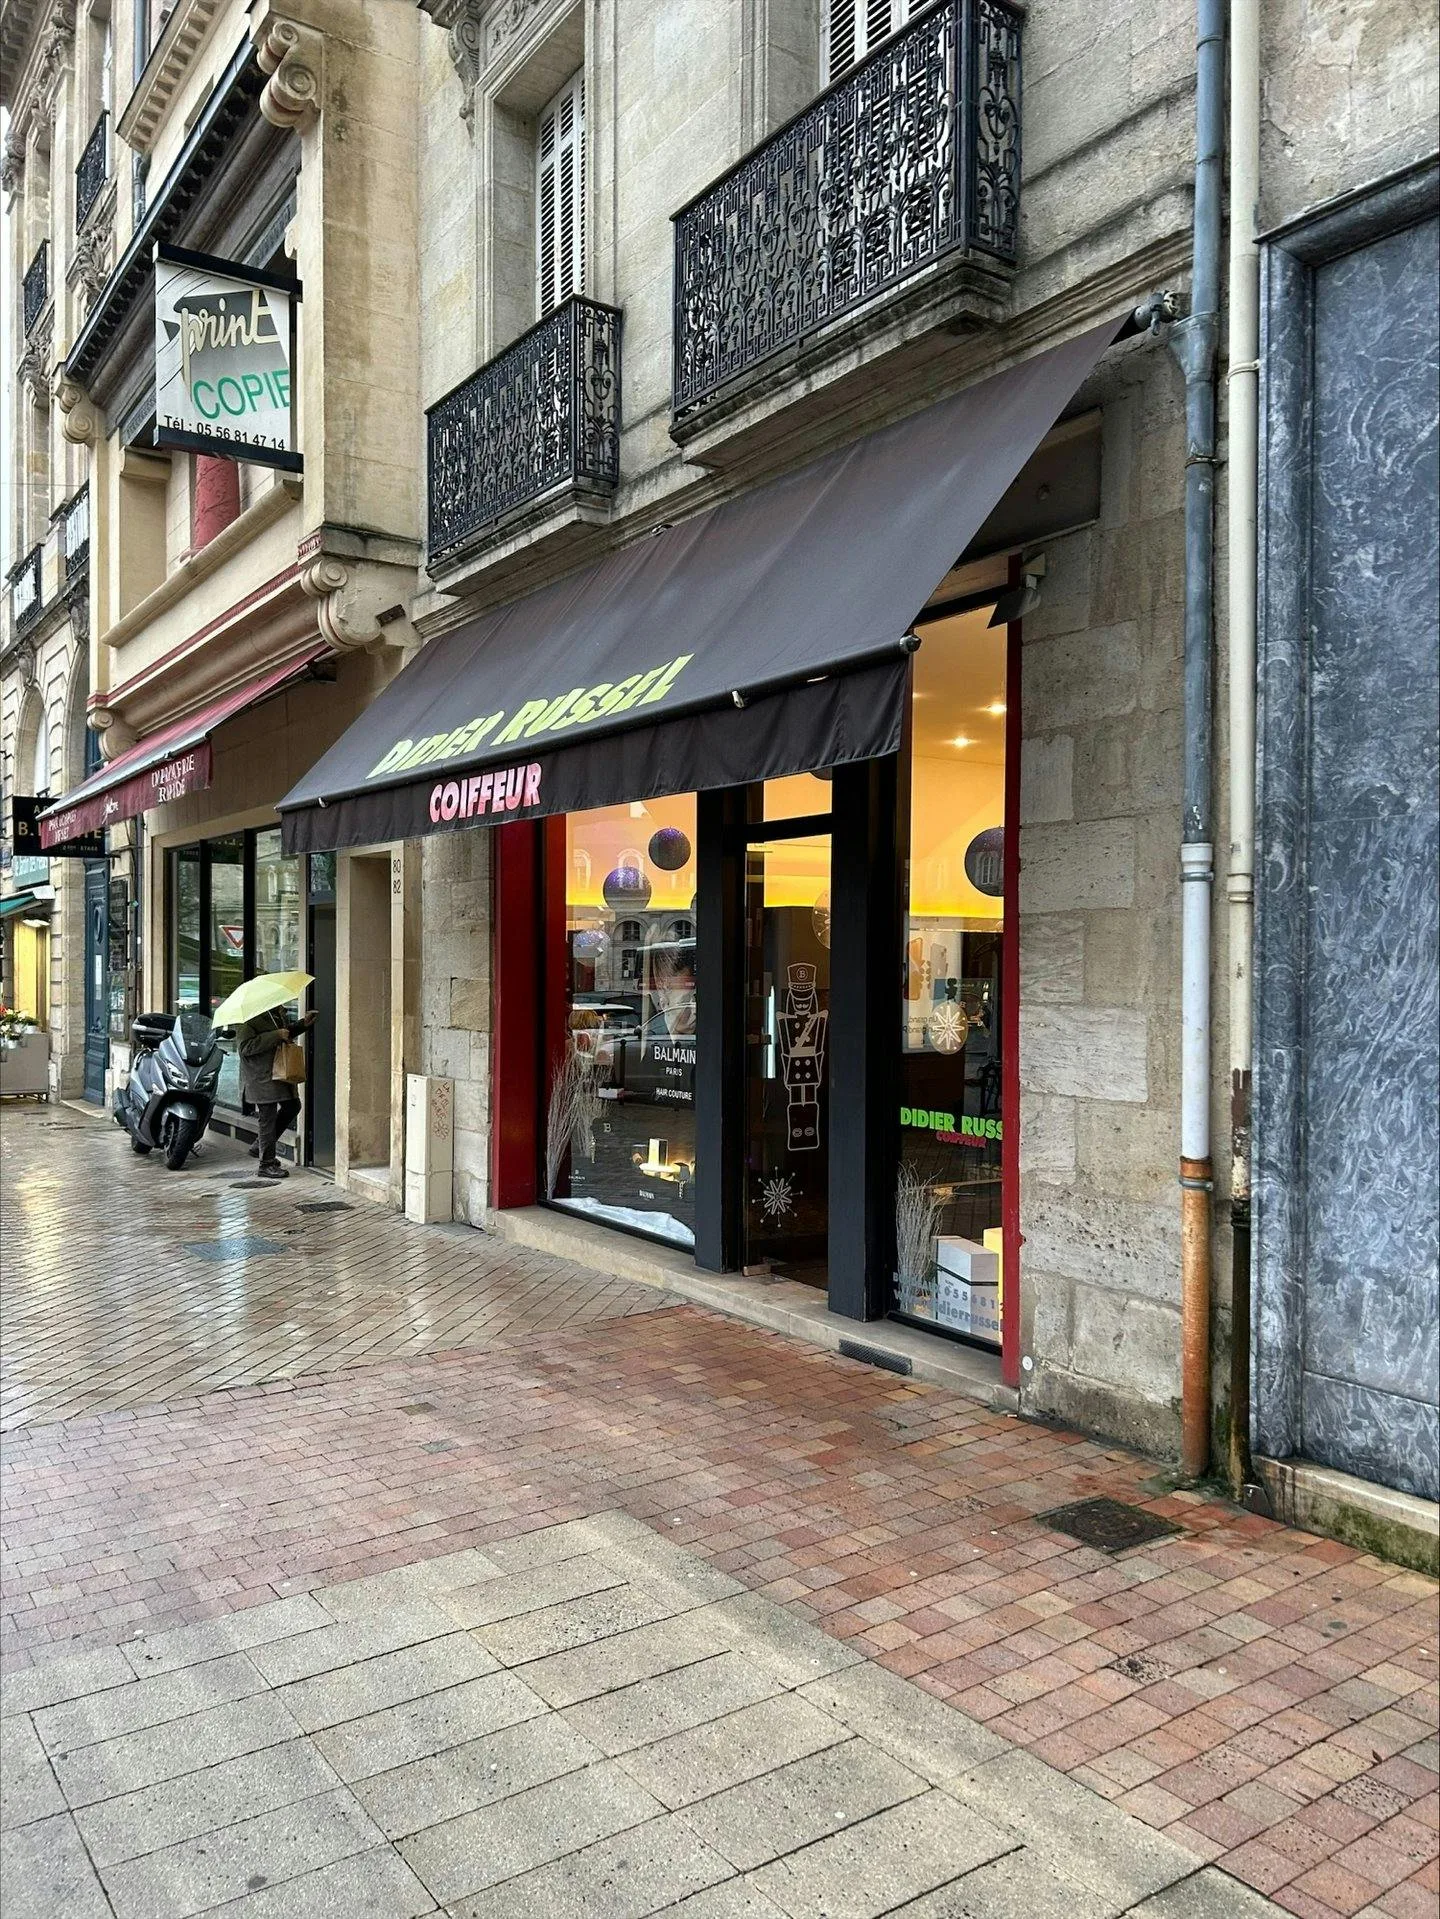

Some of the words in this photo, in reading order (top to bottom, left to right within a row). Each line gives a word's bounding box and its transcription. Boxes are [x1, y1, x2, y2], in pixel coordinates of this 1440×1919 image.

[193, 369, 290, 420] COPIE
[164, 415, 184, 430] Tél
[197, 422, 212, 437] 05
[216, 426, 230, 440] 56
[234, 430, 247, 443] 81
[252, 434, 267, 447] 47
[271, 438, 285, 451] 14
[365, 710, 505, 780] DIDIER
[489, 652, 696, 747] RUSSEL
[429, 762, 542, 823] COIFFEUR
[654, 1045, 697, 1065] BALMAIN
[665, 1066, 683, 1077] PARIS
[655, 1087, 668, 1097] HAIR
[668, 1089, 693, 1101] COUTURE
[900, 1106, 956, 1133] DIDIER
